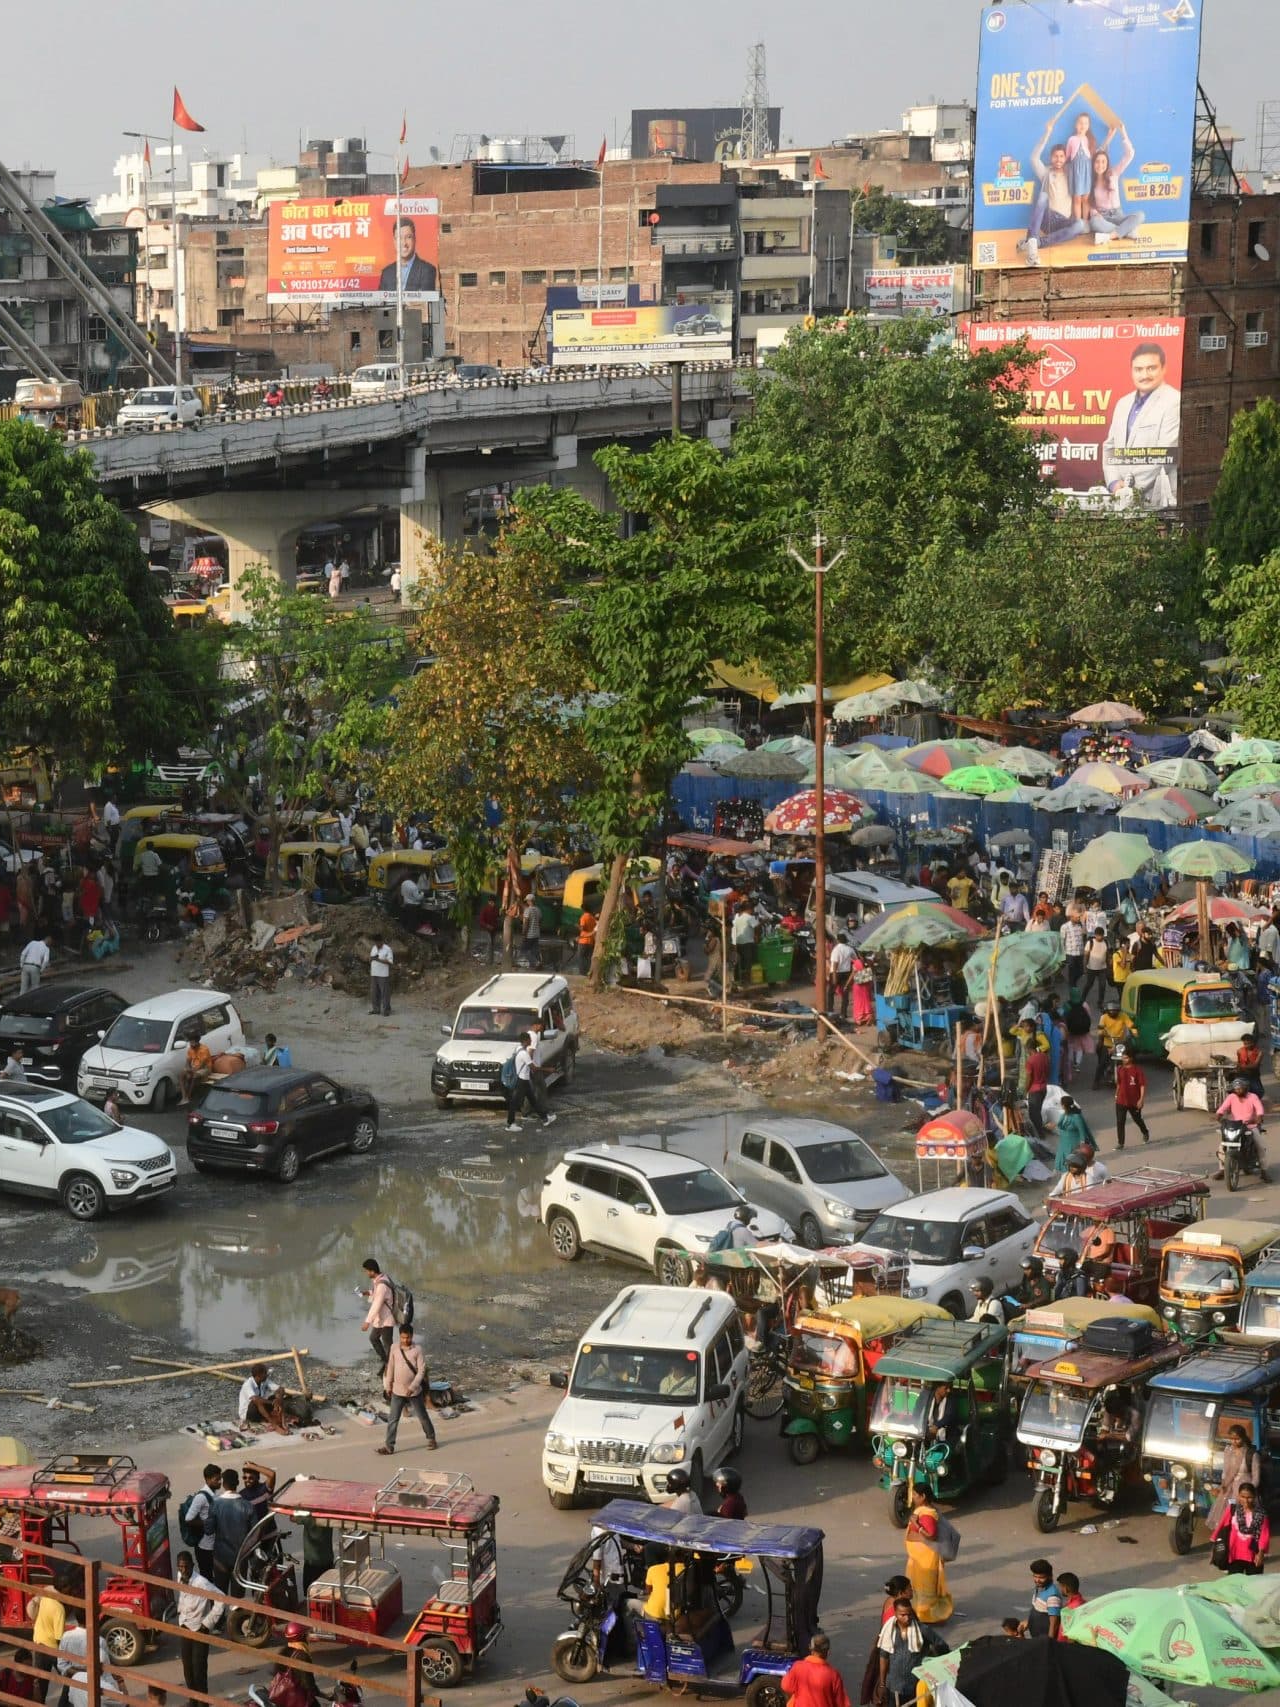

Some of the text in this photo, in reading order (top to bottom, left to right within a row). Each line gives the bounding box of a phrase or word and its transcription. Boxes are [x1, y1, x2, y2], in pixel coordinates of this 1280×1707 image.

[991, 69, 1065, 100] ONE-STOP
[990, 96, 1064, 109] FOR TWIN DREAMS
[1002, 189, 1022, 202] 7.90
[1149, 183, 1171, 197] 8.20
[281, 202, 310, 220] कोटा
[312, 203, 329, 219] का
[281, 217, 372, 241] अब पटना में
[290, 279, 360, 290] 9031017641/42
[975, 326, 1005, 342] India's
[1063, 324, 1101, 340] Channel
[1102, 326, 1114, 339] on
[1135, 323, 1180, 338] YouTube
[1055, 367, 1069, 376] TV
[1082, 389, 1112, 410] TV
[1048, 414, 1059, 425] of
[1059, 415, 1080, 425] New
[1081, 414, 1106, 425] India
[1061, 437, 1099, 461] चैनल
[1124, 448, 1146, 456] Manish
